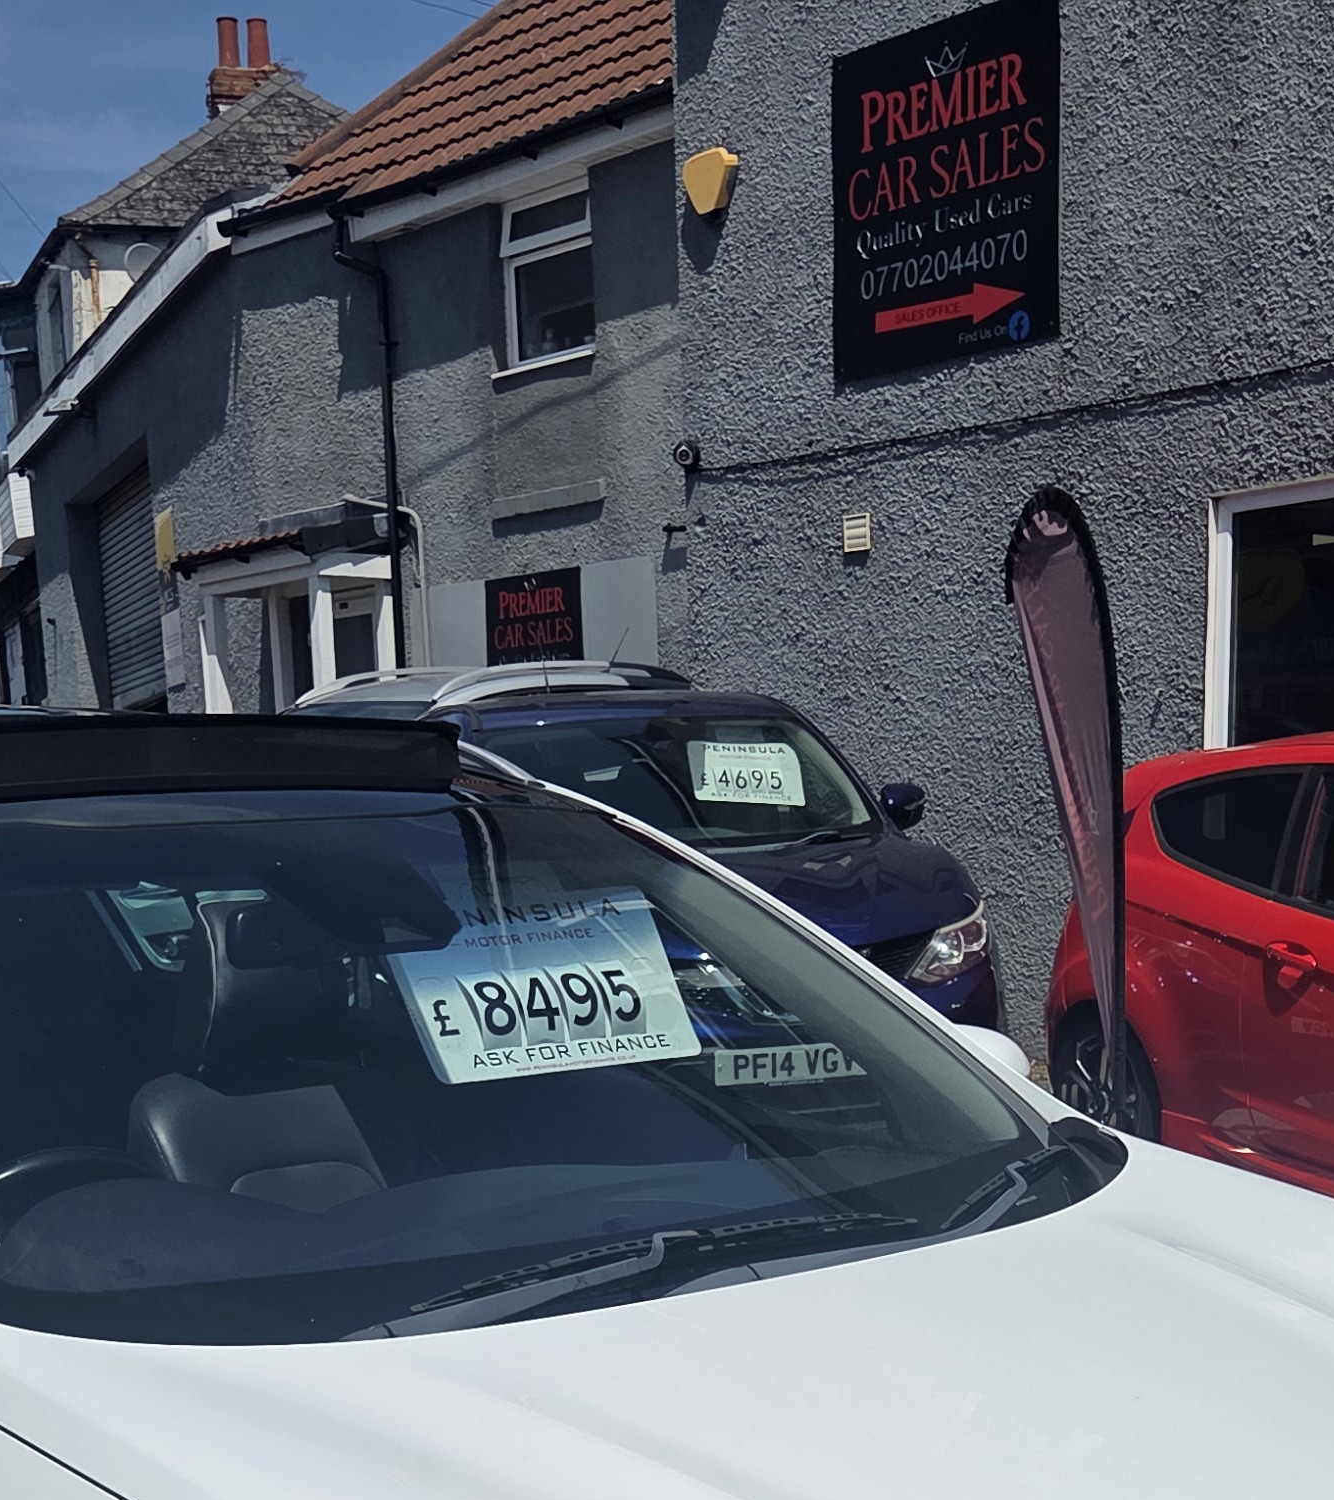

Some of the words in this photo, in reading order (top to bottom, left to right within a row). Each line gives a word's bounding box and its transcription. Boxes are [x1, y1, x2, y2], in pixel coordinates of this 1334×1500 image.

[861, 53, 1027, 153] PREMIER
[848, 155, 921, 221] CAR
[929, 117, 1045, 199] SALES
[856, 220, 927, 260] Quality
[934, 199, 981, 234] Used
[987, 191, 1032, 220] Cars
[860, 229, 1028, 300] 07702044070
[895, 308, 925, 325] SALES
[927, 301, 961, 318] OFFICE
[958, 331, 977, 345] Find
[979, 329, 993, 340] Us
[994, 325, 1008, 337] On
[499, 587, 565, 619] PREMIER
[494, 623, 524, 649] CAR
[527, 616, 574, 646] SALES
[703, 743, 786, 754] PENINSULA
[718, 769, 782, 789] 4695
[463, 897, 622, 928] NINSULA
[464, 934, 523, 949] MOTOR
[528, 928, 595, 944] FINANCE
[473, 969, 643, 1036] 8495
[473, 1049, 521, 1069] ASK
[525, 1044, 572, 1063] FOR
[578, 1033, 672, 1057] FINANCE
[733, 1052, 795, 1080] PF14
